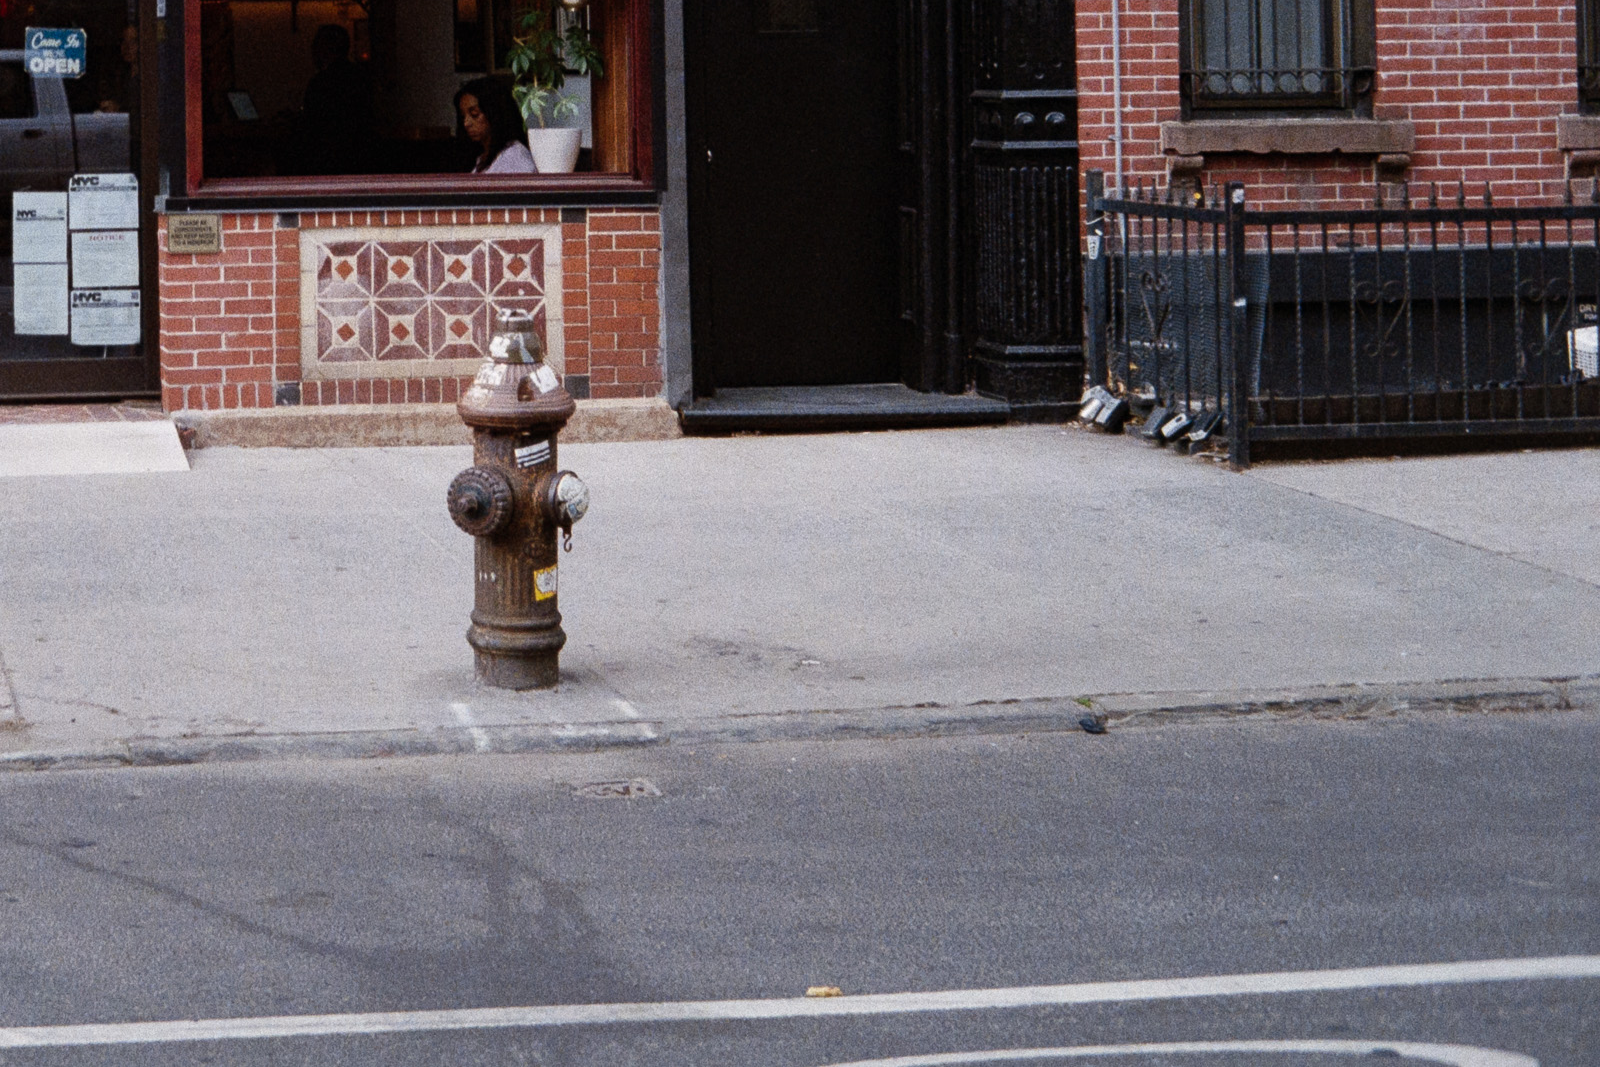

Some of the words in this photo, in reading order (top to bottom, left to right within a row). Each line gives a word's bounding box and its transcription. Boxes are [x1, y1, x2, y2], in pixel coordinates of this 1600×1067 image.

[31, 32, 62, 50] Come
[64, 33, 80, 49] In
[29, 57, 80, 74] OPEN
[71, 176, 99, 186] NYC
[16, 209, 37, 218] NYC
[73, 292, 102, 303] NYC
